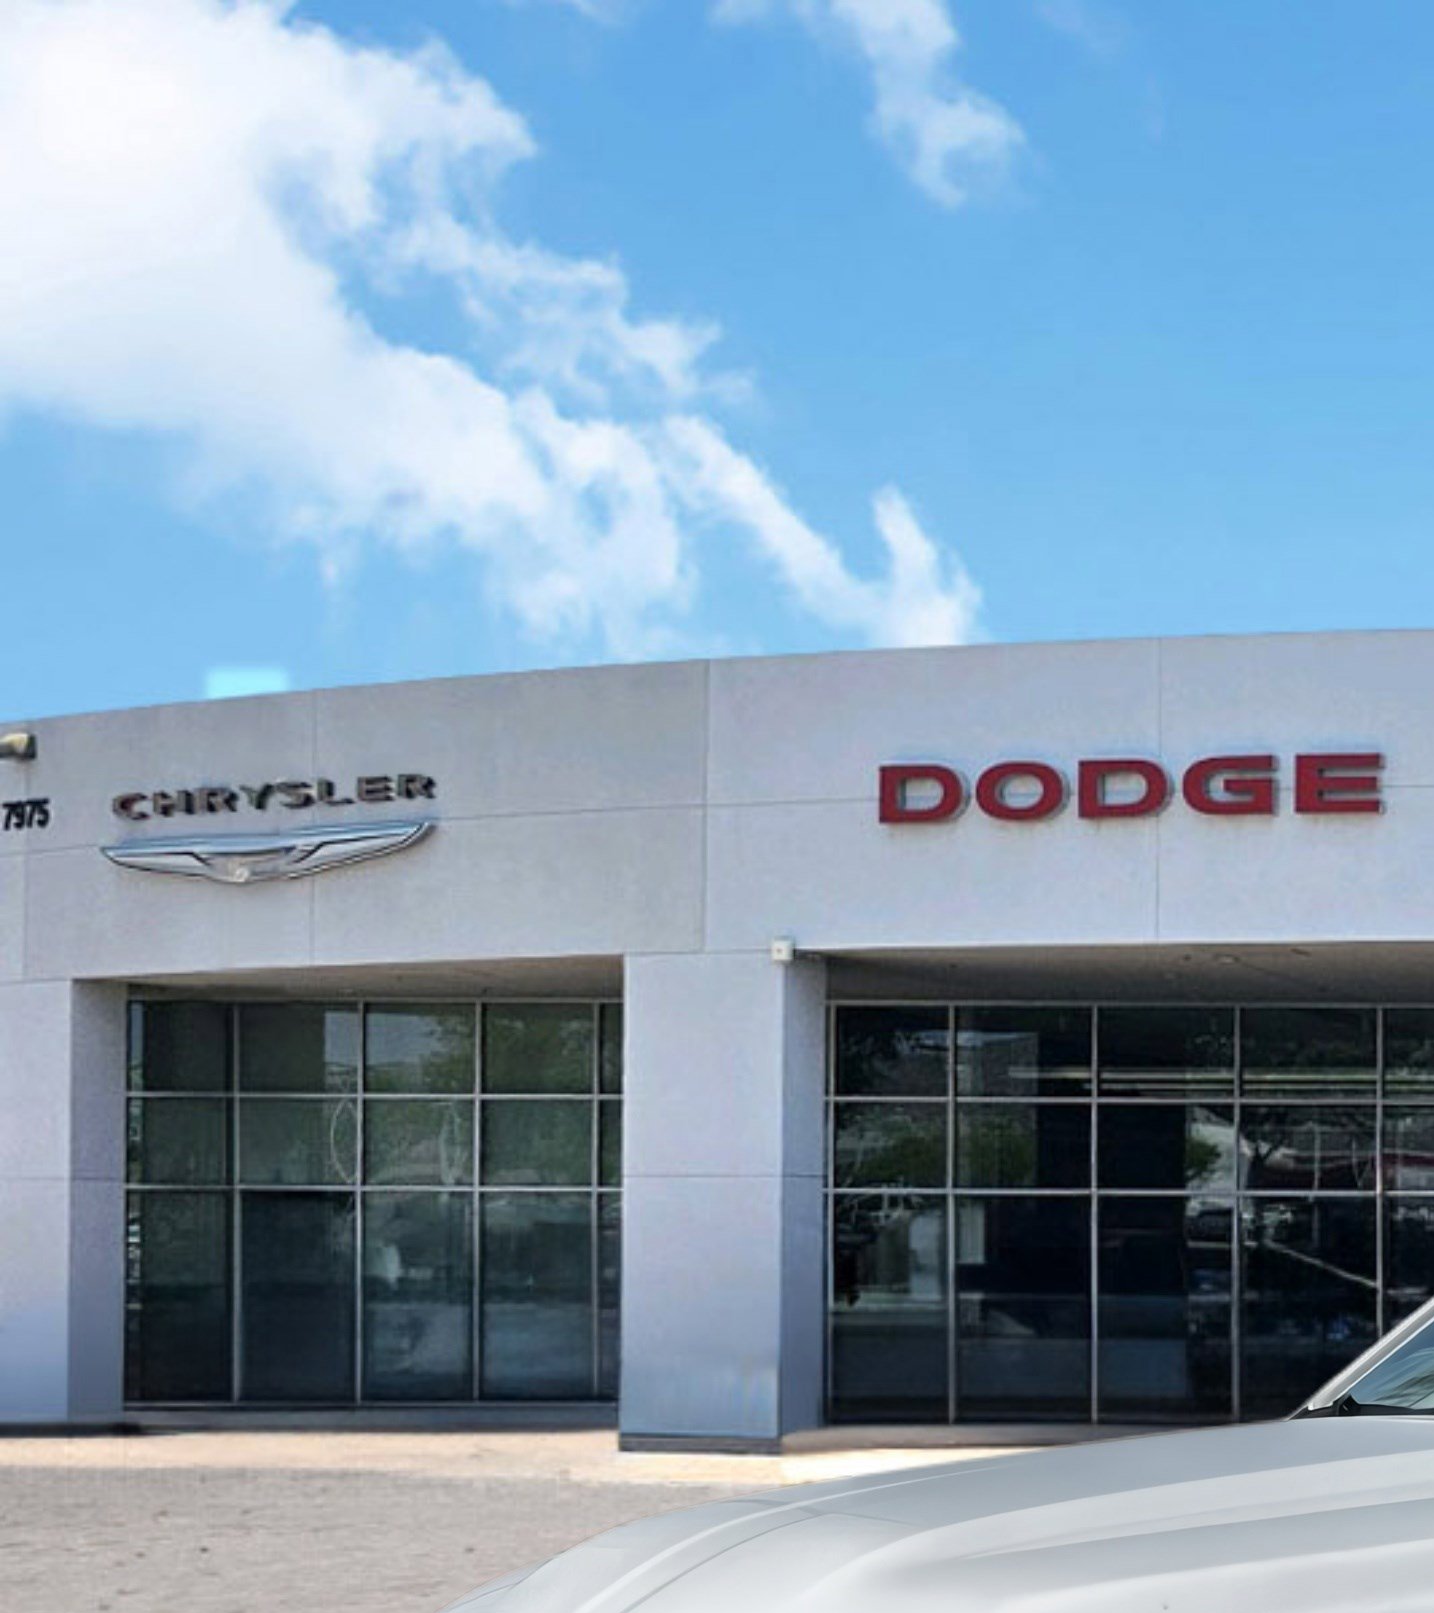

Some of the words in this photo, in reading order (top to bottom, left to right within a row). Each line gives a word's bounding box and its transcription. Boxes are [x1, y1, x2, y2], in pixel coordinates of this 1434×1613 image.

[112, 773, 437, 821] CHRYSLER
[879, 753, 1385, 824] DODGE
[2, 798, 50, 831] 7975
